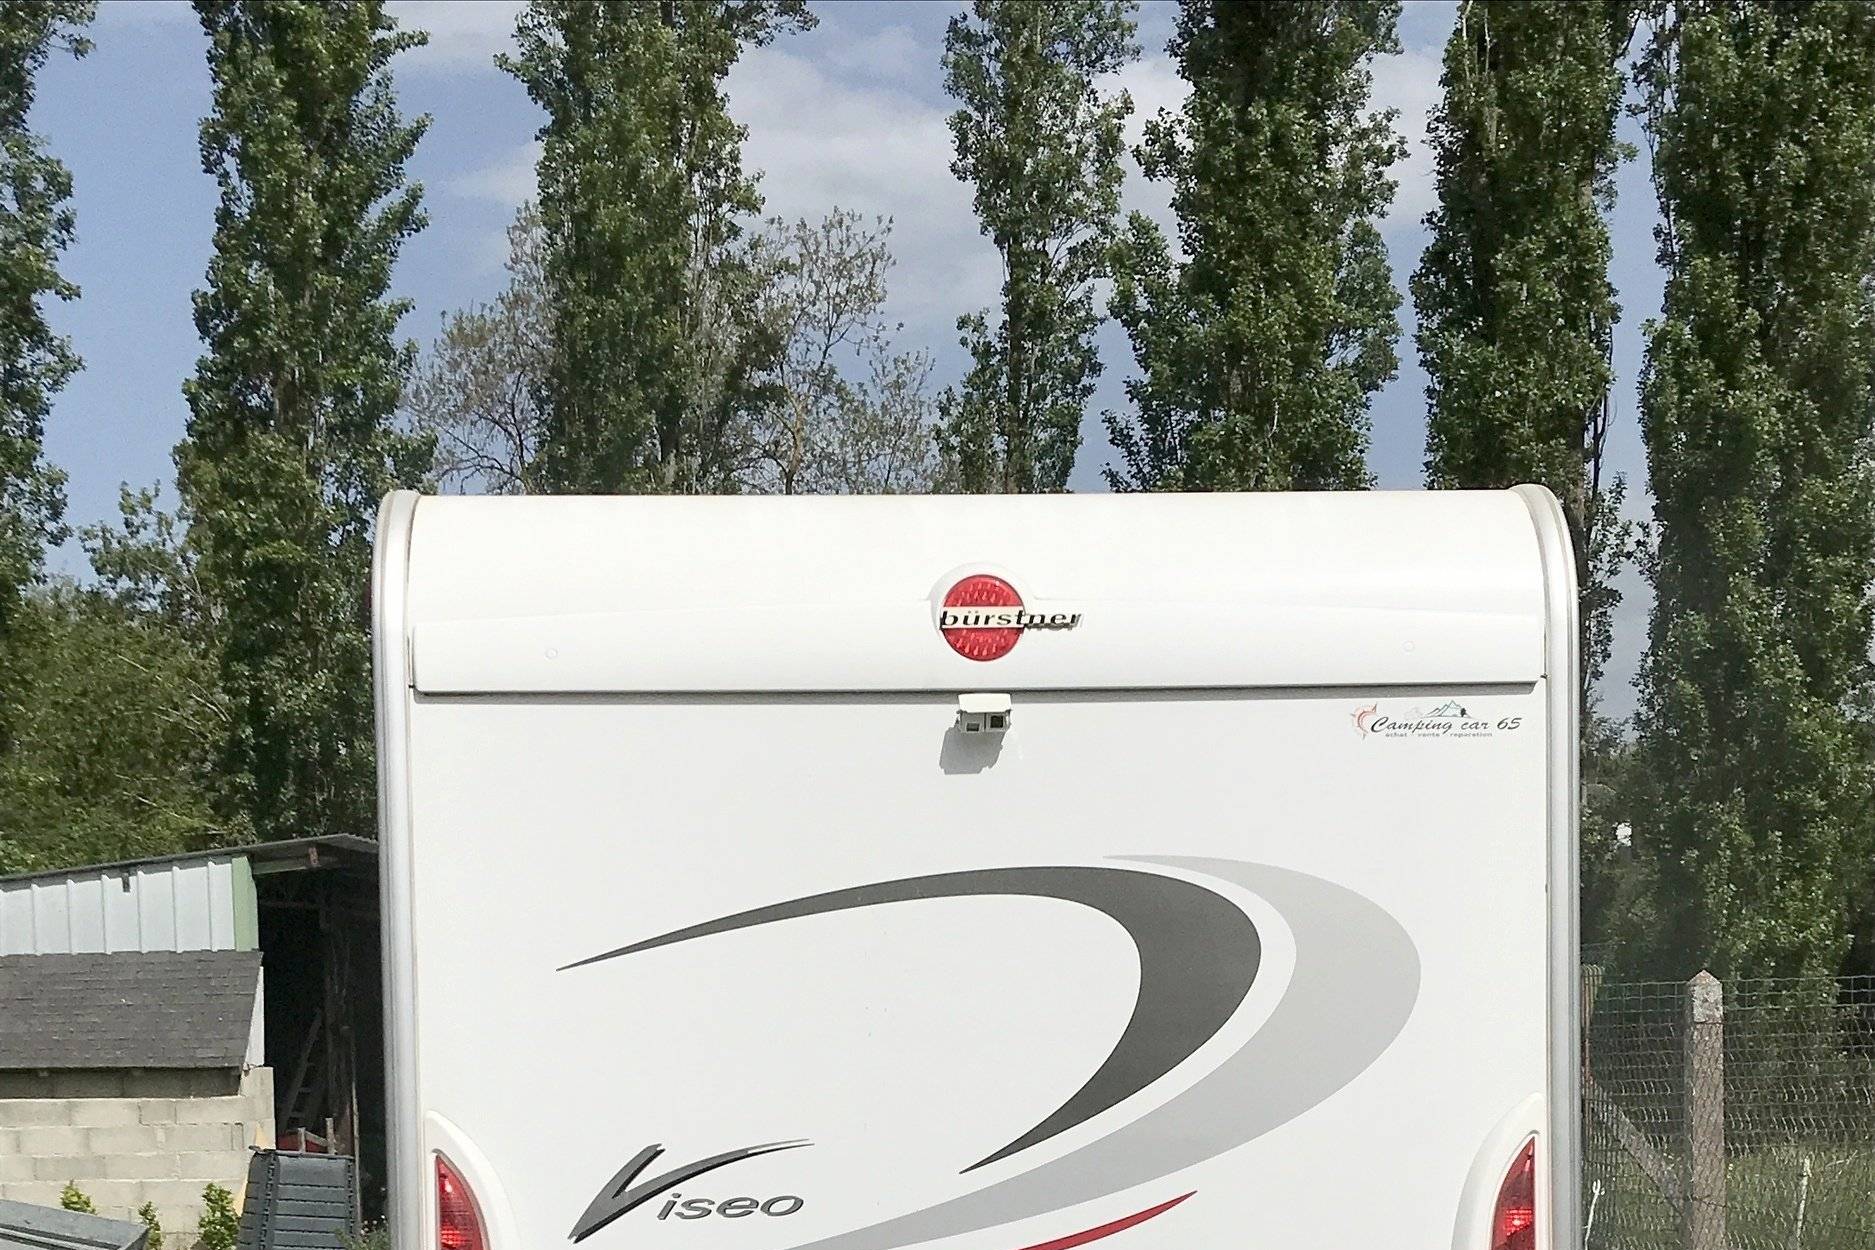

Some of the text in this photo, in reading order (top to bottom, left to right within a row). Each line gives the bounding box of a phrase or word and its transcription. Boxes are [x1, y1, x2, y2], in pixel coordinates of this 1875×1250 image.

[941, 609, 1081, 627] bürstner
[1370, 716, 1523, 735] Camping car 65
[567, 1137, 816, 1245] Viseo
